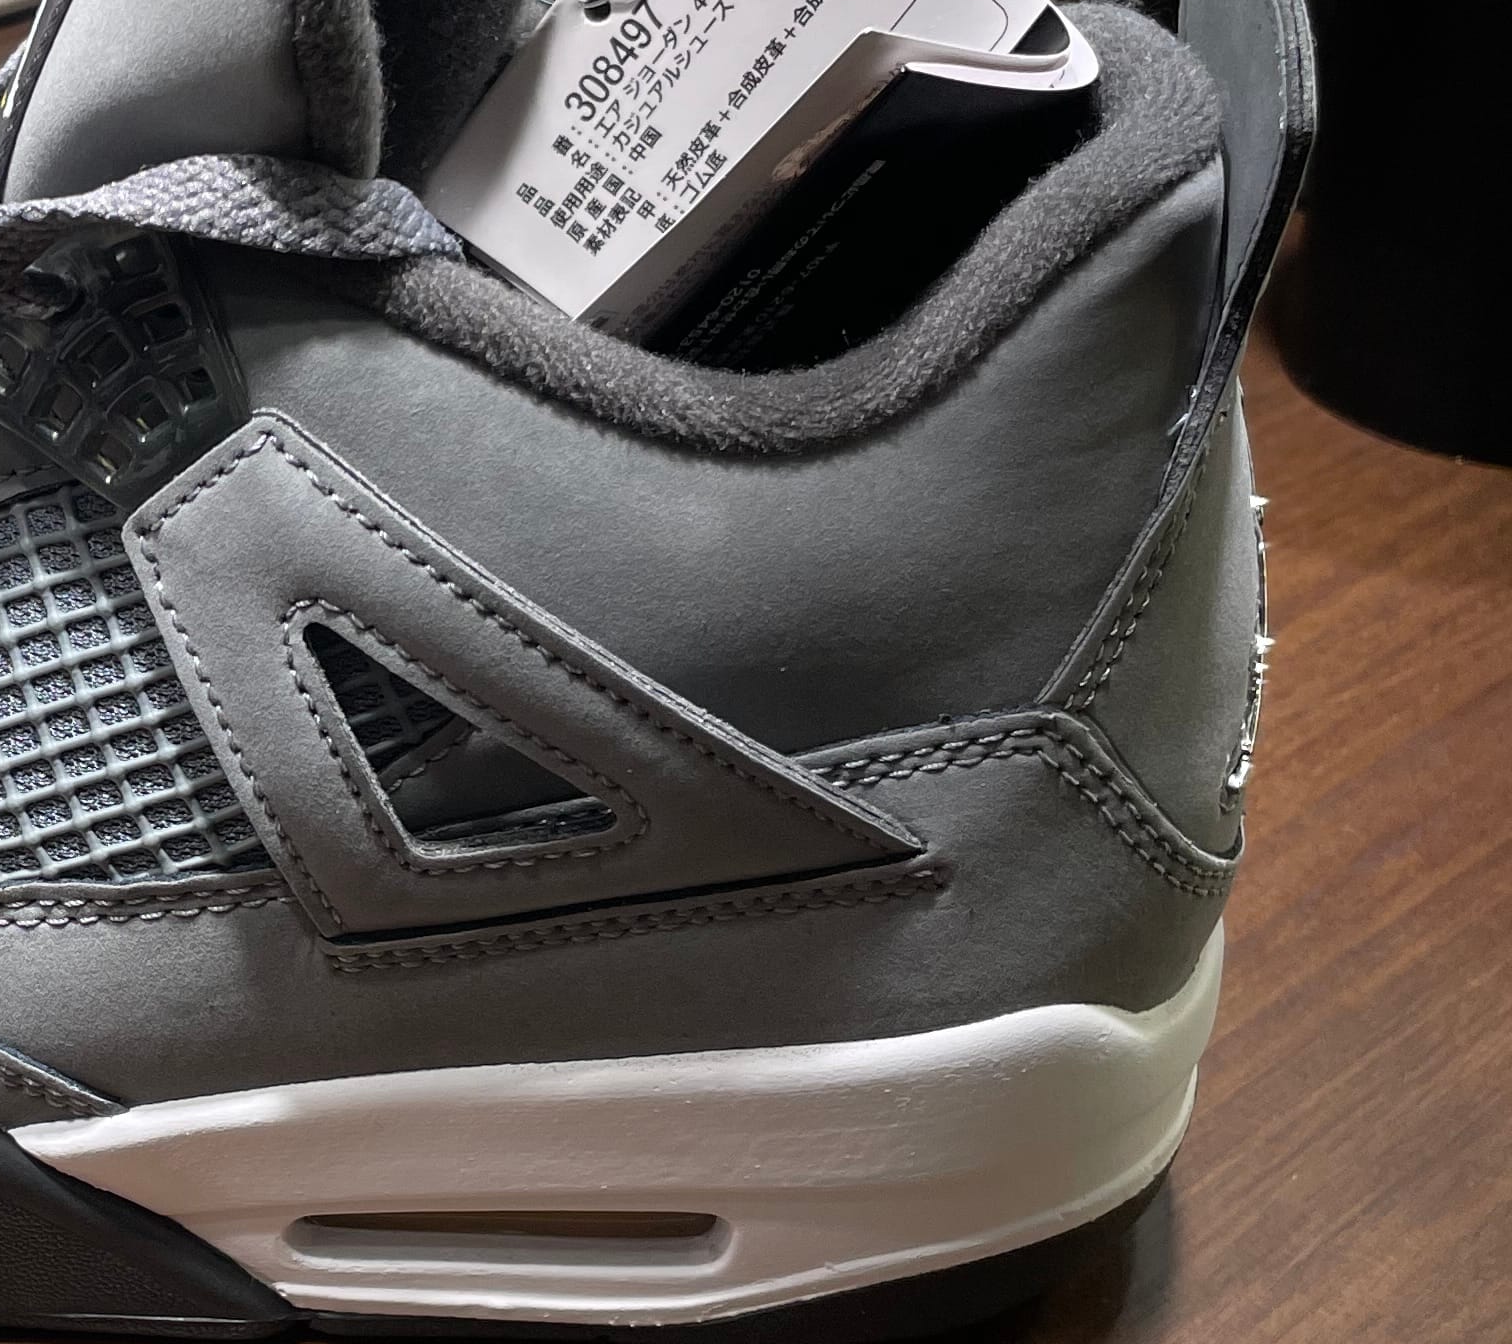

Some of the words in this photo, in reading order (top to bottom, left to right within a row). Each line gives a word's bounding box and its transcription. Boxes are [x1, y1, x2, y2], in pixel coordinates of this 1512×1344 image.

[594, 99, 620, 138] エア
[623, 14, 690, 100] ジョーダン
[629, 125, 662, 161] 中国
[680, 149, 727, 204] ゴム底
[583, 187, 642, 256] 素材表記
